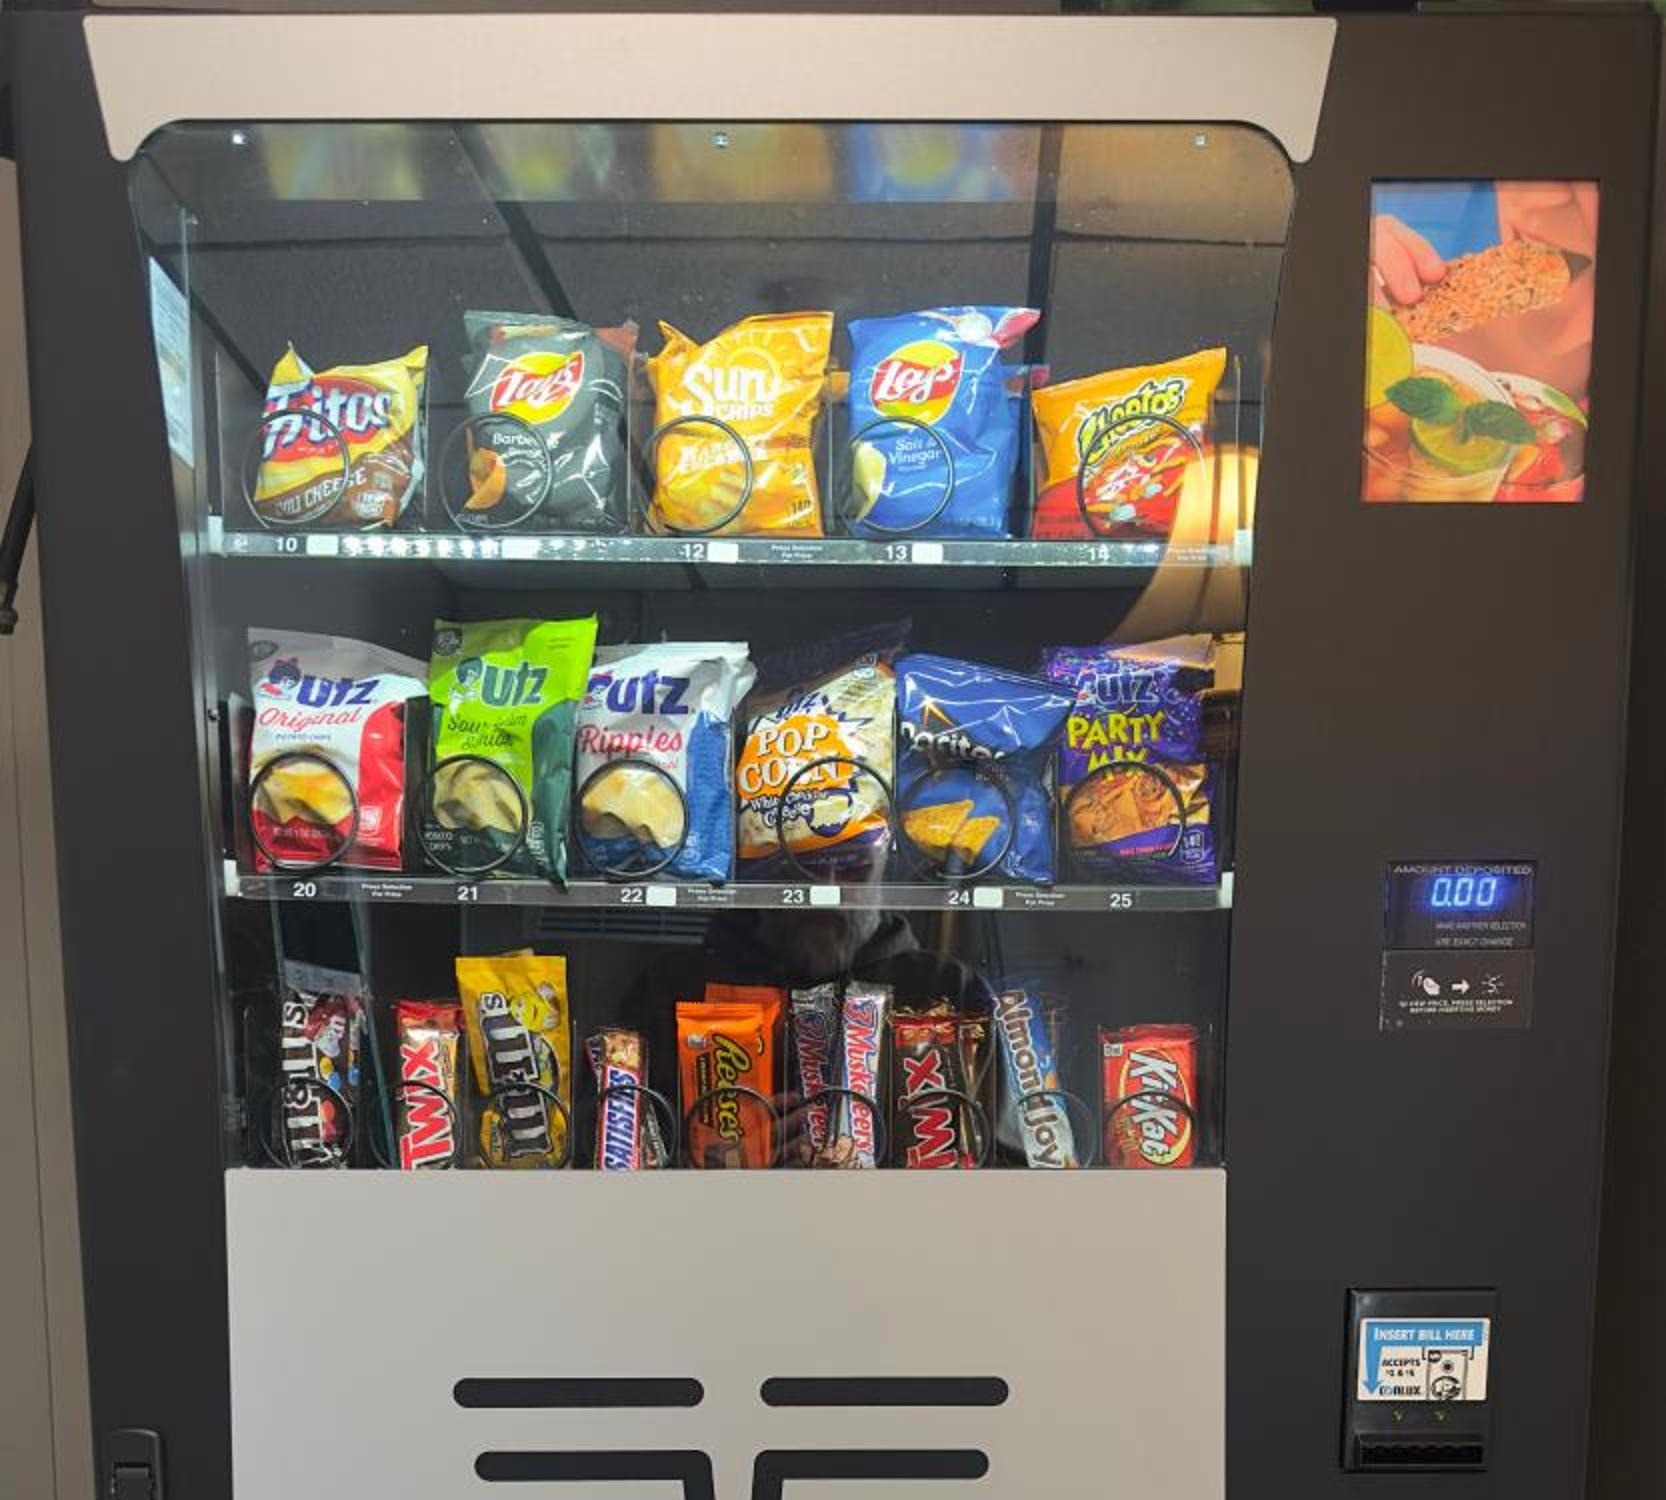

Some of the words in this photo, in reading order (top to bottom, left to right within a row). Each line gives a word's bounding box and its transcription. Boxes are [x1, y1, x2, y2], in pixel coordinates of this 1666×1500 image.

[888, 449, 943, 466] Vinegar
[304, 467, 367, 507] CHEEE
[277, 538, 298, 552] 10
[683, 543, 705, 559] 12
[886, 544, 907, 560] 13
[259, 706, 362, 733] Original
[1067, 710, 1166, 749] PARTY
[581, 723, 683, 762] Ripples
[757, 722, 830, 757] POP
[1087, 745, 1150, 781] MIX
[763, 802, 812, 827] Ceese
[293, 882, 317, 897] 20
[458, 886, 479, 901] 21
[621, 888, 643, 903] 22
[783, 889, 804, 904] 23
[948, 890, 970, 905] 24
[1431, 877, 1497, 907] 0.00
[1110, 893, 1132, 908] 25
[994, 989, 1056, 1111] Almond
[847, 1022, 876, 1153] Muskeeers
[1024, 1110, 1065, 1167] Joy
[1375, 1327, 1415, 1341] INSERT
[1418, 1329, 1443, 1341] BILL
[1445, 1329, 1475, 1341] HERE
[1382, 1358, 1421, 1367] ACCEPTS
